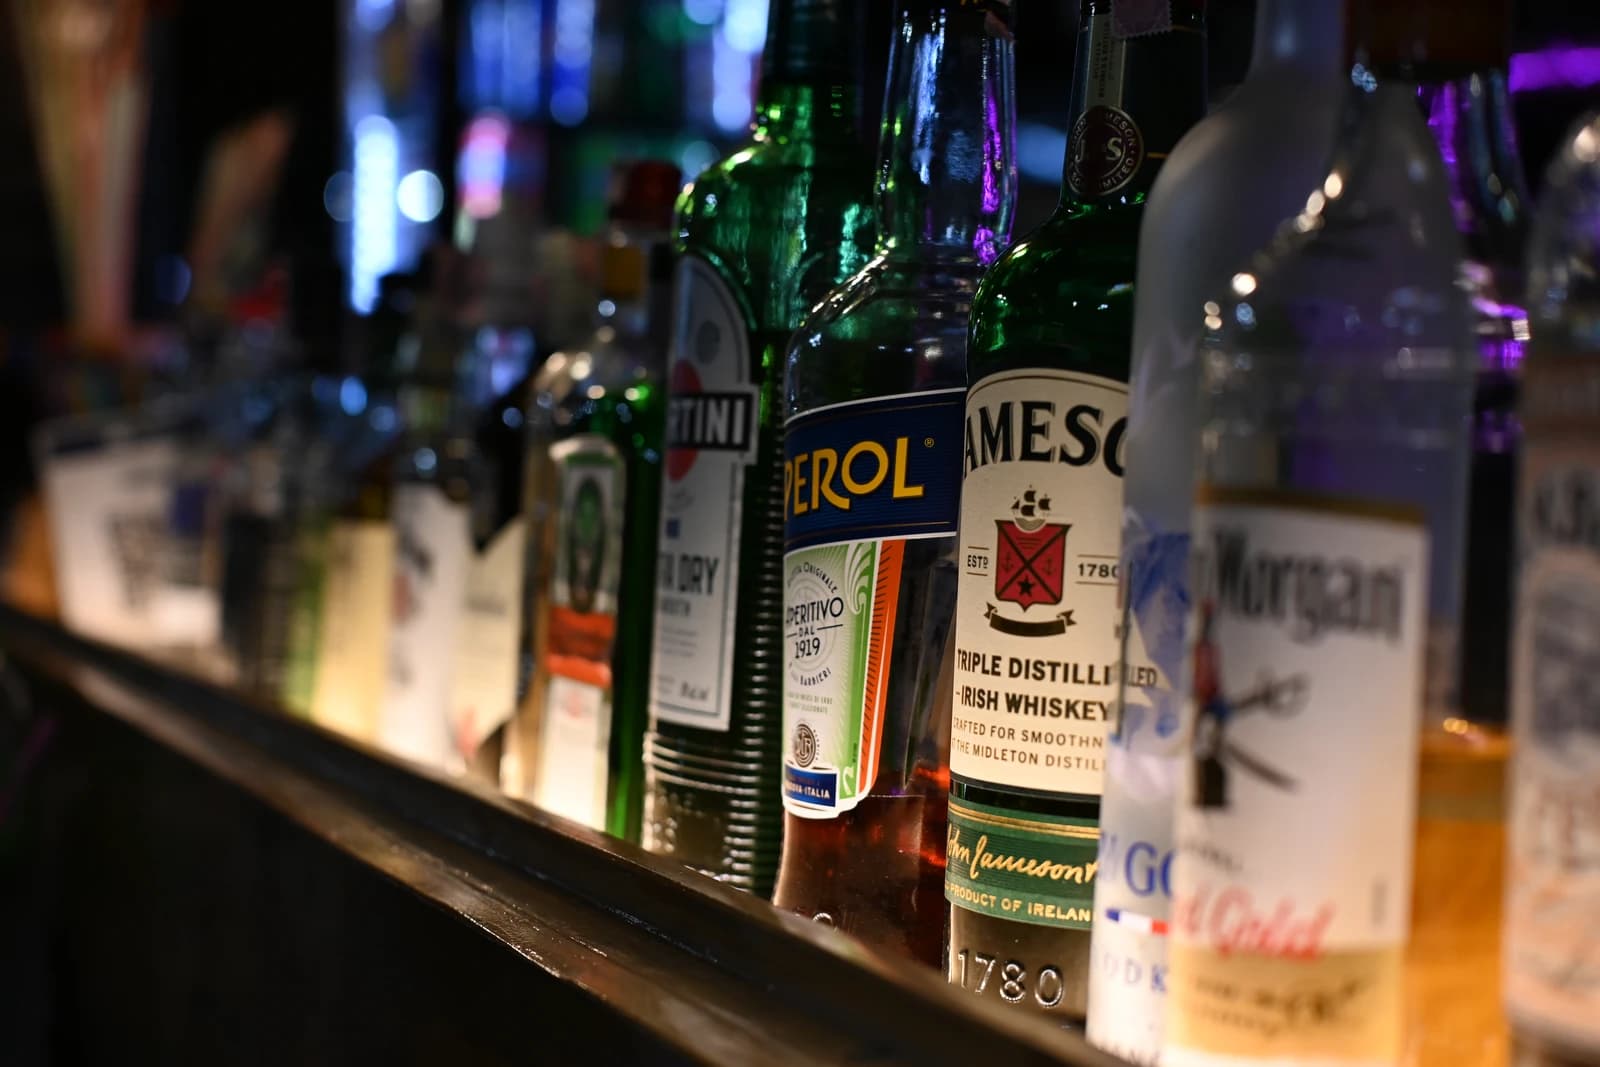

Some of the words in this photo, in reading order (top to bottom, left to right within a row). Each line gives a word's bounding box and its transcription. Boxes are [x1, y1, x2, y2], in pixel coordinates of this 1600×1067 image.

[798, 625, 816, 638] DAL
[795, 637, 821, 659] 1919
[957, 648, 1002, 677] TRIPLE
[962, 685, 999, 712] IRISH
[1005, 693, 1108, 721] WHISKEY
[990, 725, 1016, 741] FOR
[1021, 729, 1104, 749] SMOOTHN
[957, 739, 970, 754] THE
[972, 744, 1039, 766] MIDLETON
[969, 834, 1082, 885] Jameson
[950, 882, 996, 908] PRODUCT
[1001, 898, 1022, 912] OF
[1028, 902, 1091, 922] IRELAN
[957, 949, 1065, 1008] 1780
